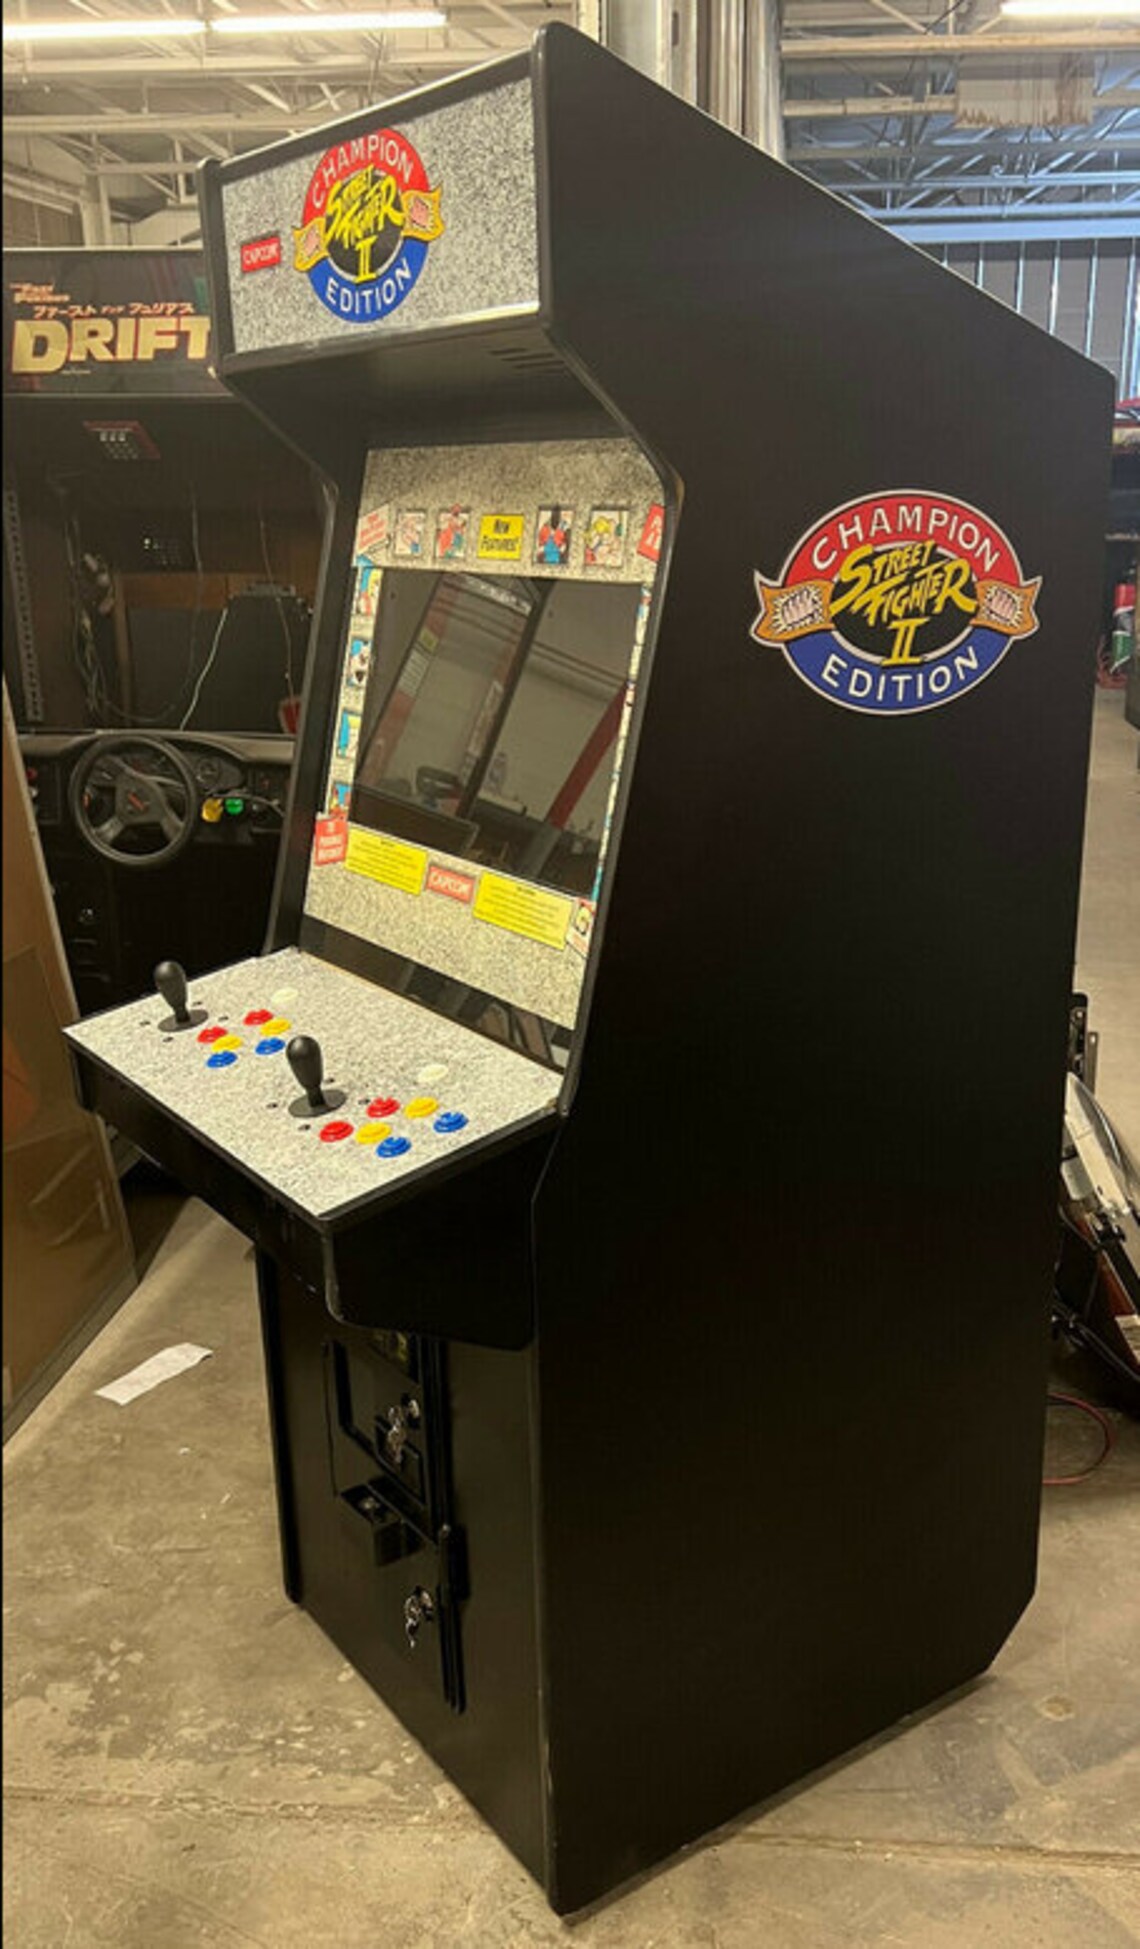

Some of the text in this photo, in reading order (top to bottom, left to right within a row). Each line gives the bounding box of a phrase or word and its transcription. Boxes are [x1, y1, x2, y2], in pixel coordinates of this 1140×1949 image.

[312, 134, 414, 209] CHAMPION
[323, 164, 374, 248] STREET
[336, 175, 404, 249] FIGHTER
[243, 243, 278, 265] CAPCOM
[354, 236, 378, 283] II
[326, 258, 412, 314] EDITION
[12, 317, 211, 374] DRIFT
[812, 505, 1001, 572] CHAMPION
[830, 540, 935, 616] STREET
[851, 559, 977, 627] FIGHTER
[881, 617, 931, 666] II
[821, 647, 979, 702] EDITION
[431, 870, 470, 894] CAPCOM
